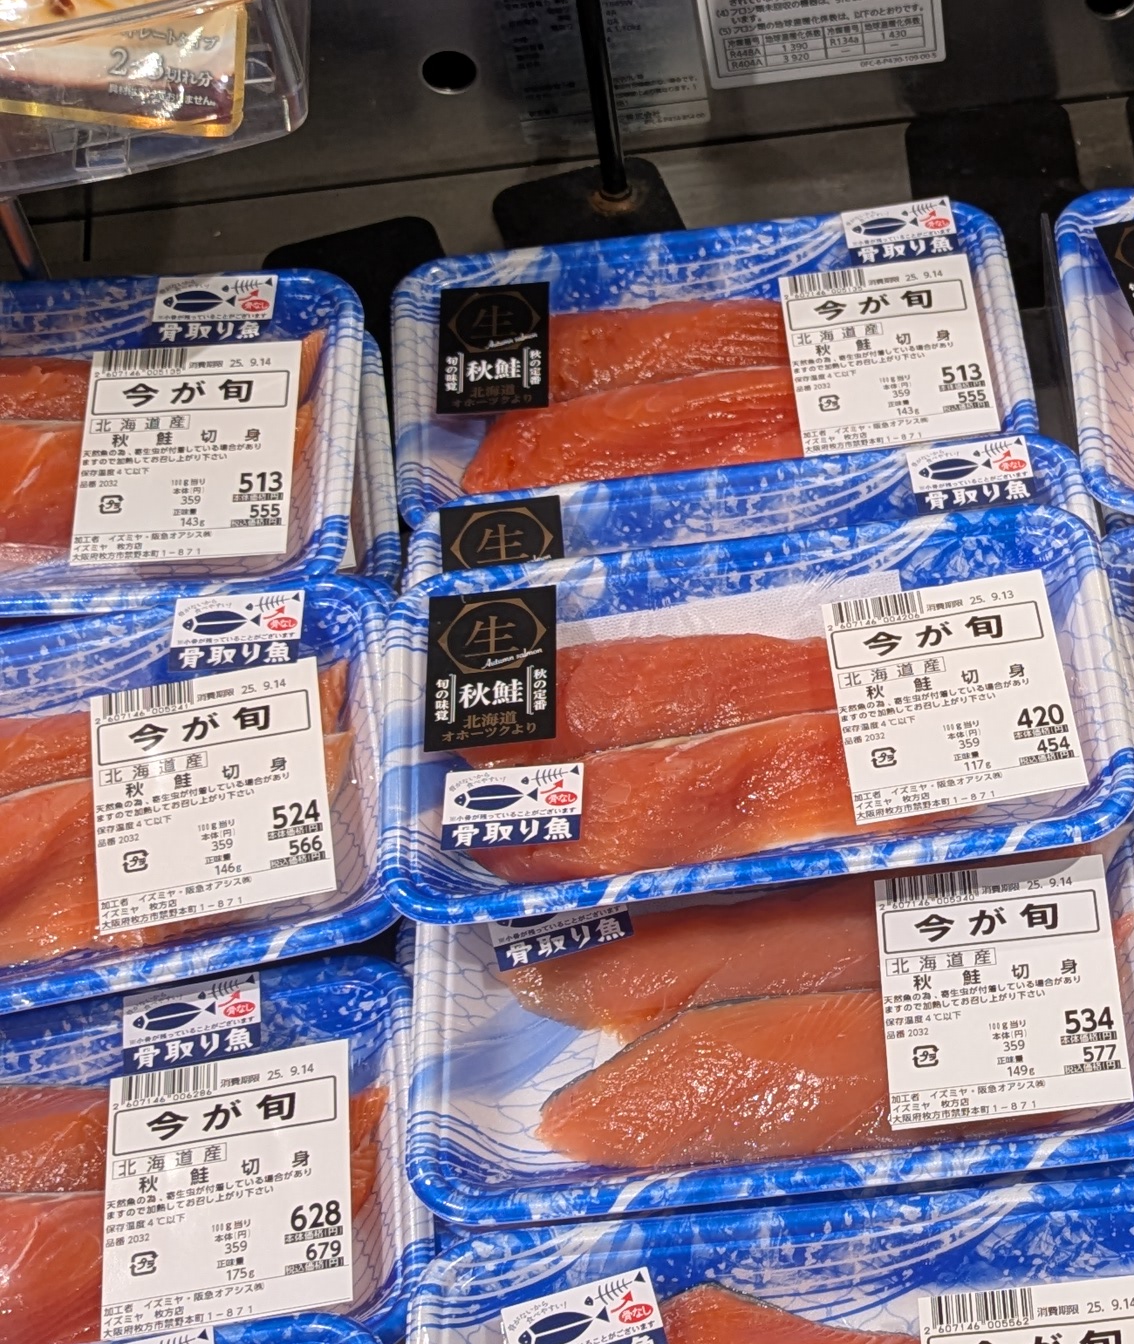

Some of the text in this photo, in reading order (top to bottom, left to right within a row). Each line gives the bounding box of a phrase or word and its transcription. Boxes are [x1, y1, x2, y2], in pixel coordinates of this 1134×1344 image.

[857, 236, 957, 266] 骨取り魚
[813, 287, 935, 323] 今が旬
[941, 362, 983, 384] 513
[121, 377, 254, 408] 今が旬
[957, 389, 986, 404] 555
[239, 471, 284, 493] 513
[924, 480, 1032, 512] 骨取り魚
[249, 503, 281, 518] 555
[862, 611, 1005, 659] 今が旬
[458, 677, 525, 707] 秋鮭
[128, 701, 271, 754] 今が旬
[1015, 703, 1065, 730] 420
[1035, 735, 1071, 754] 454
[272, 799, 321, 830] 524
[289, 835, 323, 856] 566
[451, 818, 574, 848] 骨取り魚
[914, 900, 1061, 944] 今が旬
[1064, 1006, 1114, 1034] 534
[1082, 1043, 1117, 1063] 577
[146, 1088, 296, 1144] 今が旬
[291, 1199, 341, 1232] 628
[306, 1239, 341, 1262] 679
